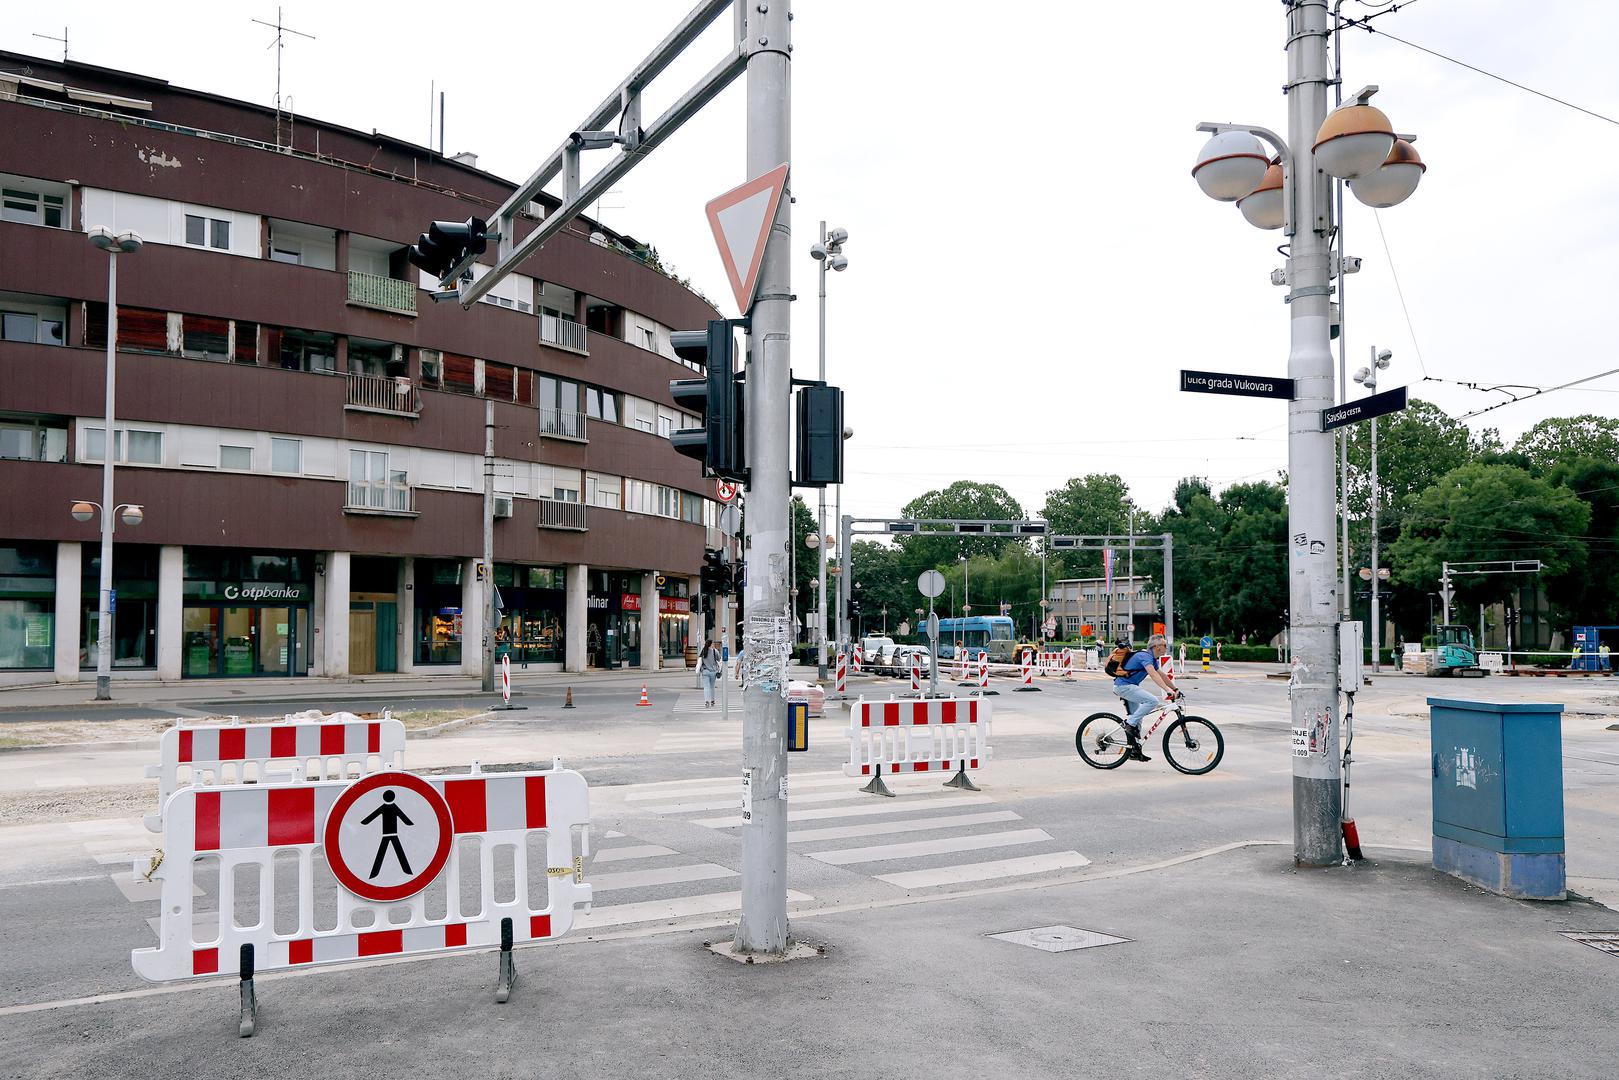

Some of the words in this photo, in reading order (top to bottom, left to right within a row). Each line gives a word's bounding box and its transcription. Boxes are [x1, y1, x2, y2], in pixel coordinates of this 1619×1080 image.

[1187, 377, 1207, 385] ULICA
[1207, 378, 1233, 390] grada
[1233, 379, 1273, 392] Vukovara
[1326, 410, 1347, 424] Savska
[1346, 407, 1362, 416] CESTA
[241, 586, 300, 601] otpbanka
